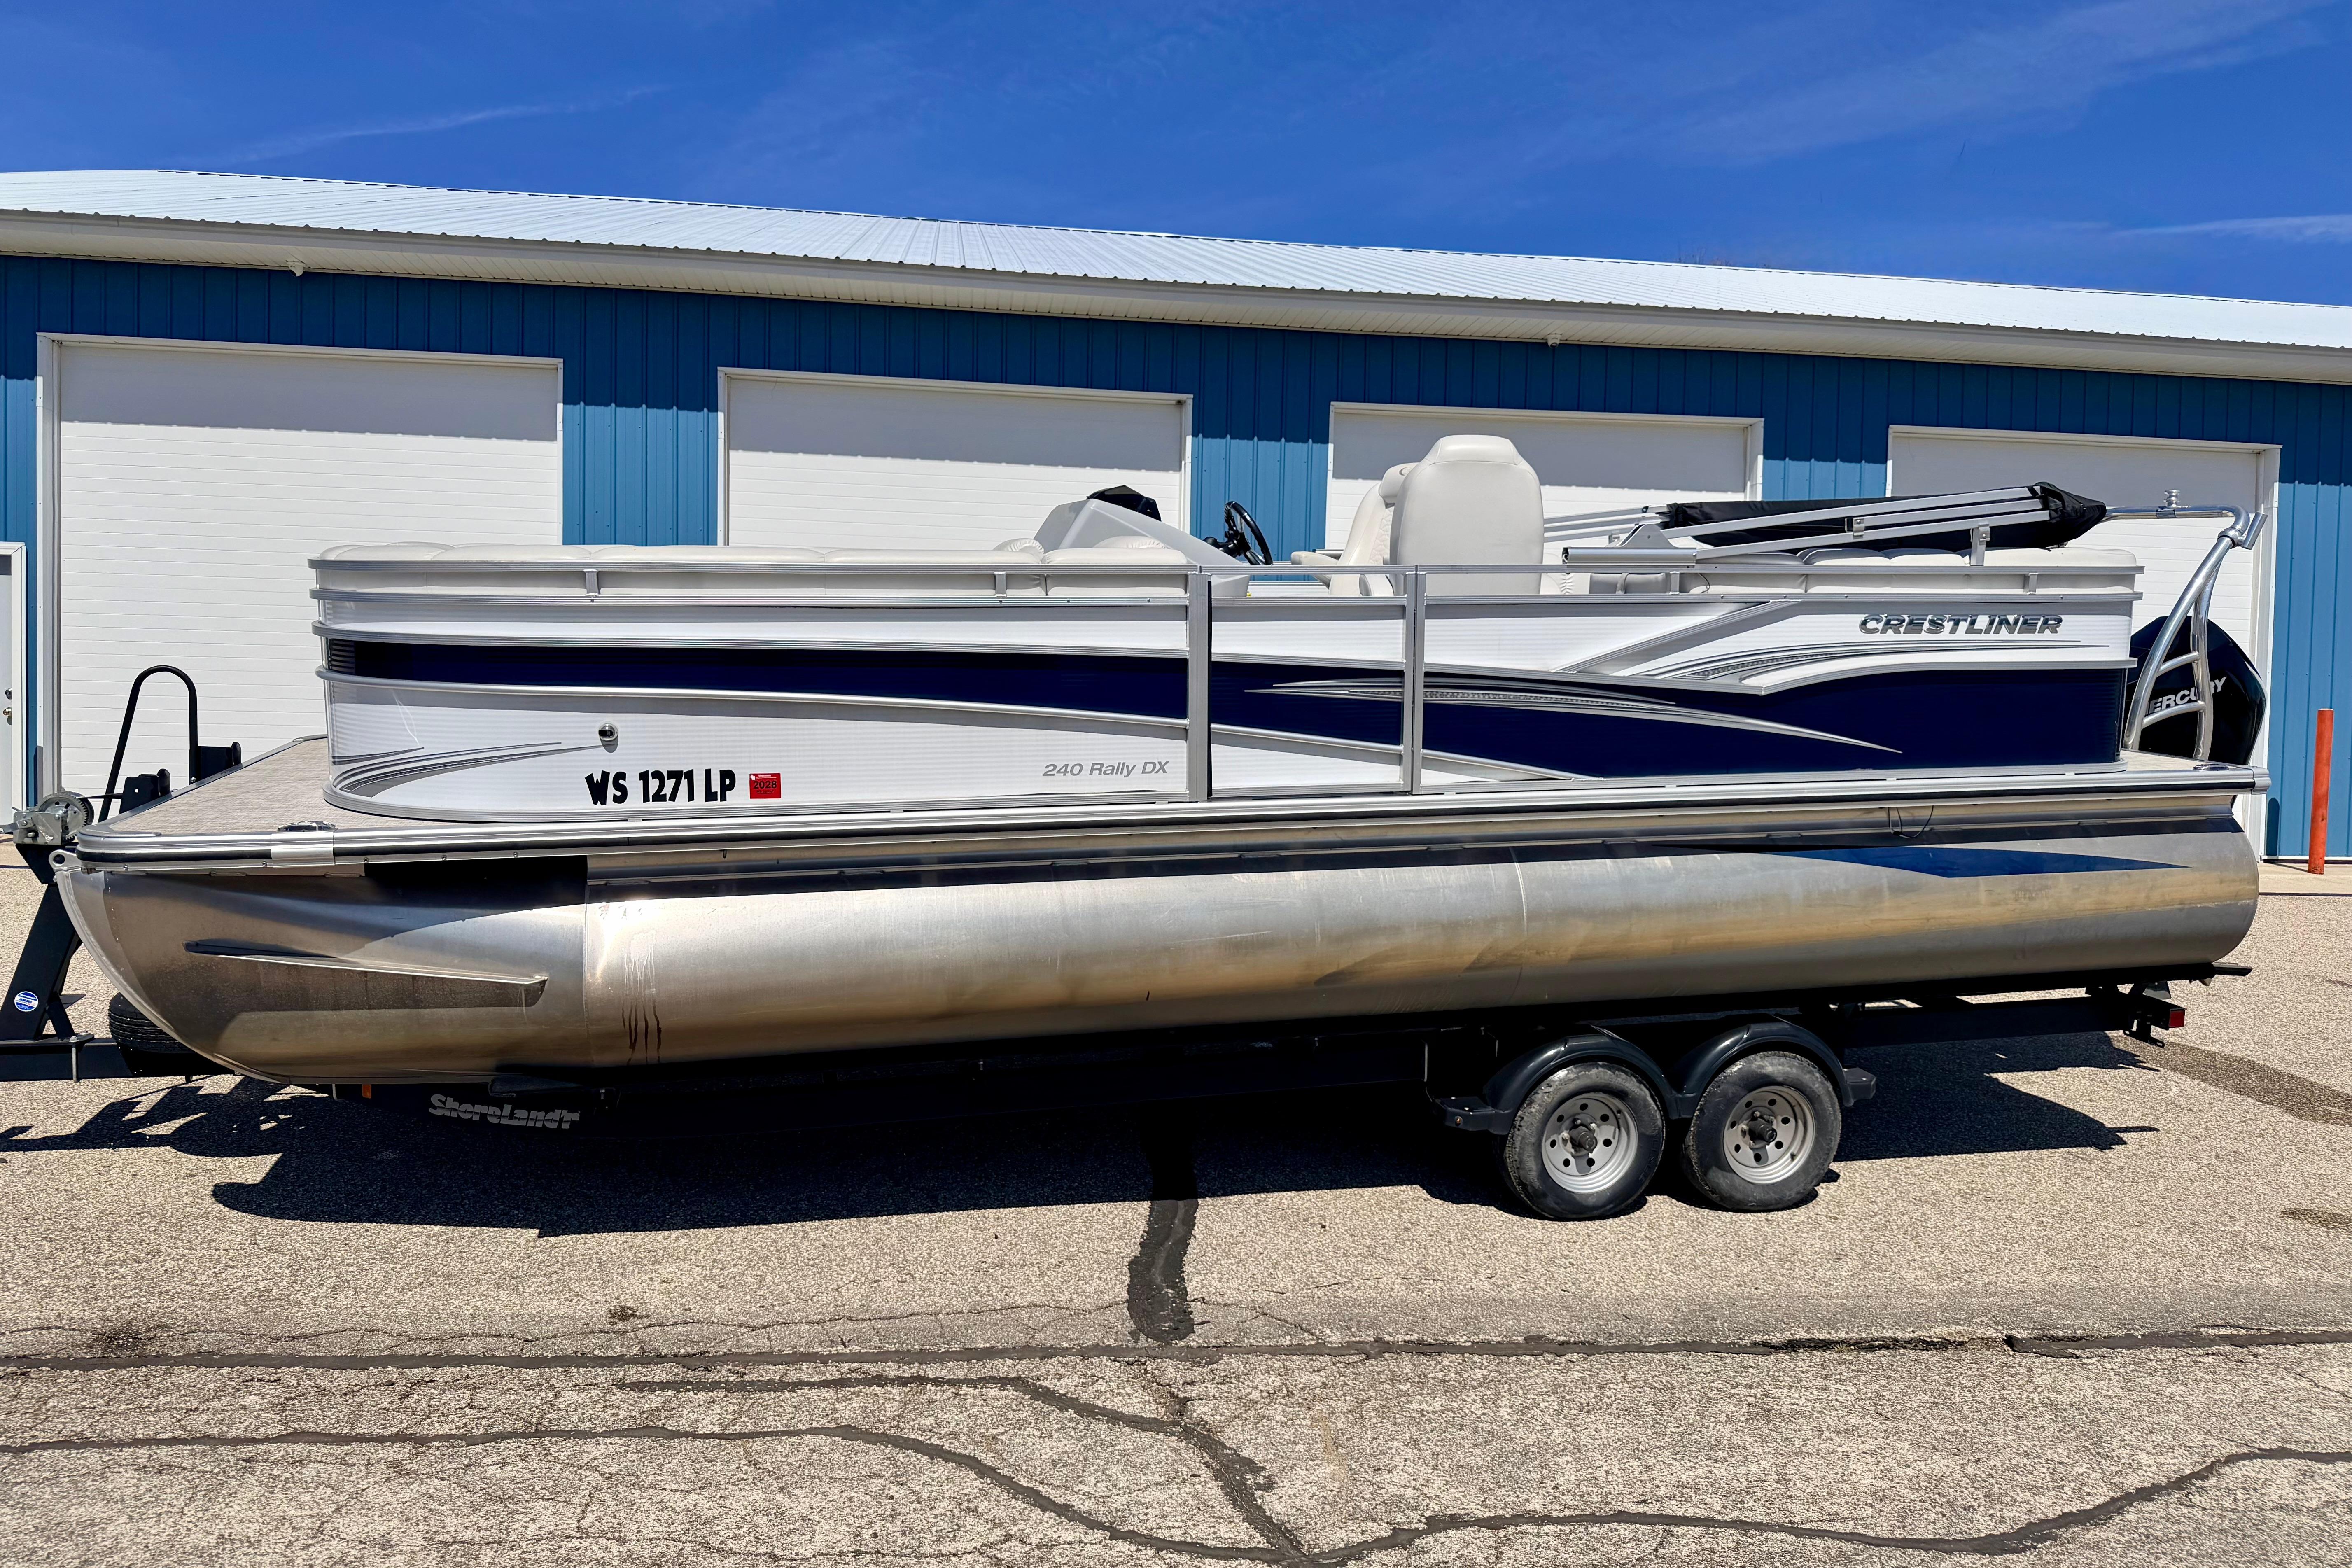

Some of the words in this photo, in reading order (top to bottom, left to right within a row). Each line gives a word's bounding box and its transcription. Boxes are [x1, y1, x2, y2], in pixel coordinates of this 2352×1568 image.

[1859, 614, 2063, 634] CRESTLINER
[1043, 763, 1083, 776] 240
[1089, 762, 1136, 778] Rally
[1141, 761, 1170, 775] DX
[585, 770, 628, 806] WS
[639, 769, 695, 803] 1271
[705, 768, 736, 803] LP
[753, 779, 777, 789] 2028
